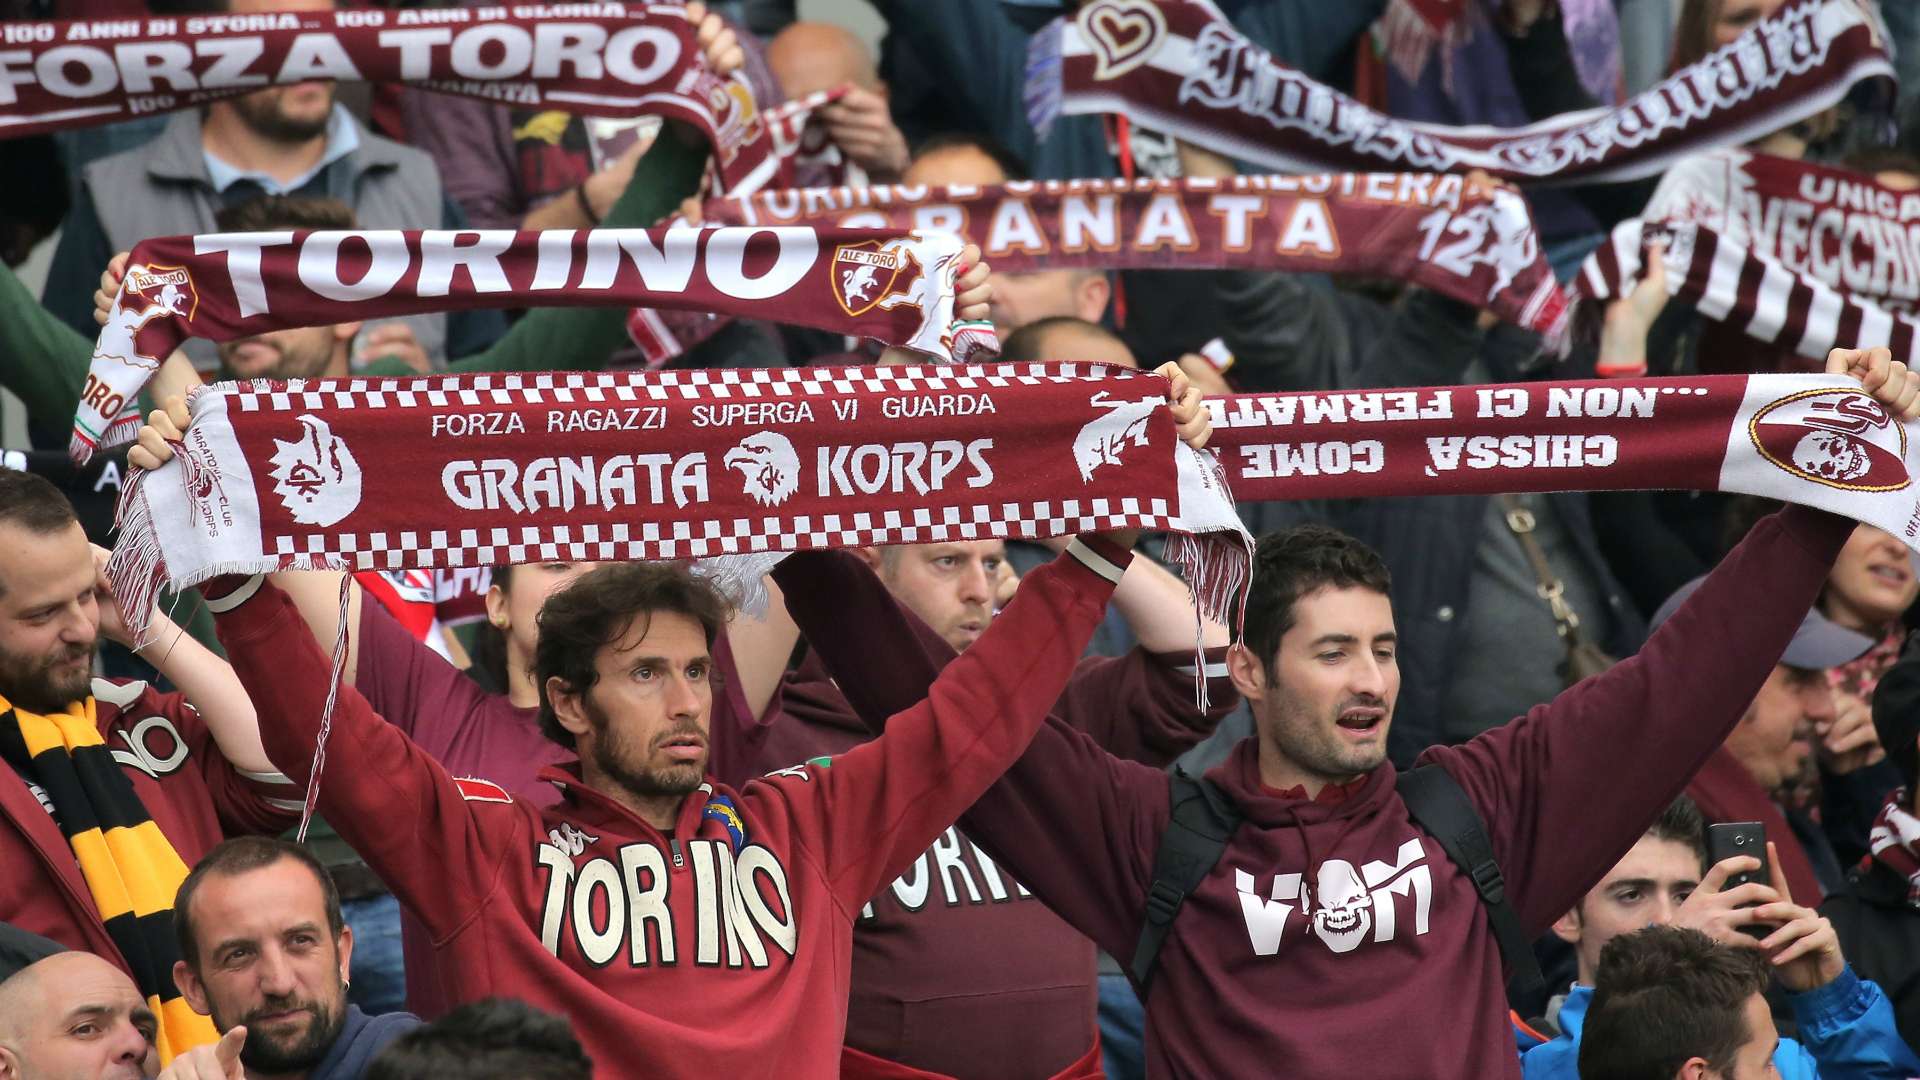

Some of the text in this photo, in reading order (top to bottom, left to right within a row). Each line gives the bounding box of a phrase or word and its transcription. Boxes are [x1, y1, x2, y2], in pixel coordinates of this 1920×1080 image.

[4, 24, 55, 44] 100
[66, 21, 140, 41] ANNI
[147, 18, 178, 36] DI
[334, 10, 386, 28] 100
[0, 33, 361, 105] FORZA
[378, 22, 683, 86] TORO
[194, 227, 818, 318] TORINO
[866, 253, 896, 268] TORO
[431, 394, 997, 438] FORZA RAGAZZI SUPERGA VI GUARDA
[1200, 390, 1453, 428] FERMATE
[1476, 388, 1529, 419] CI
[441, 438, 994, 515] GRANATA KORPS
[1239, 439, 1385, 479] COME
[537, 840, 797, 967] TORINO
